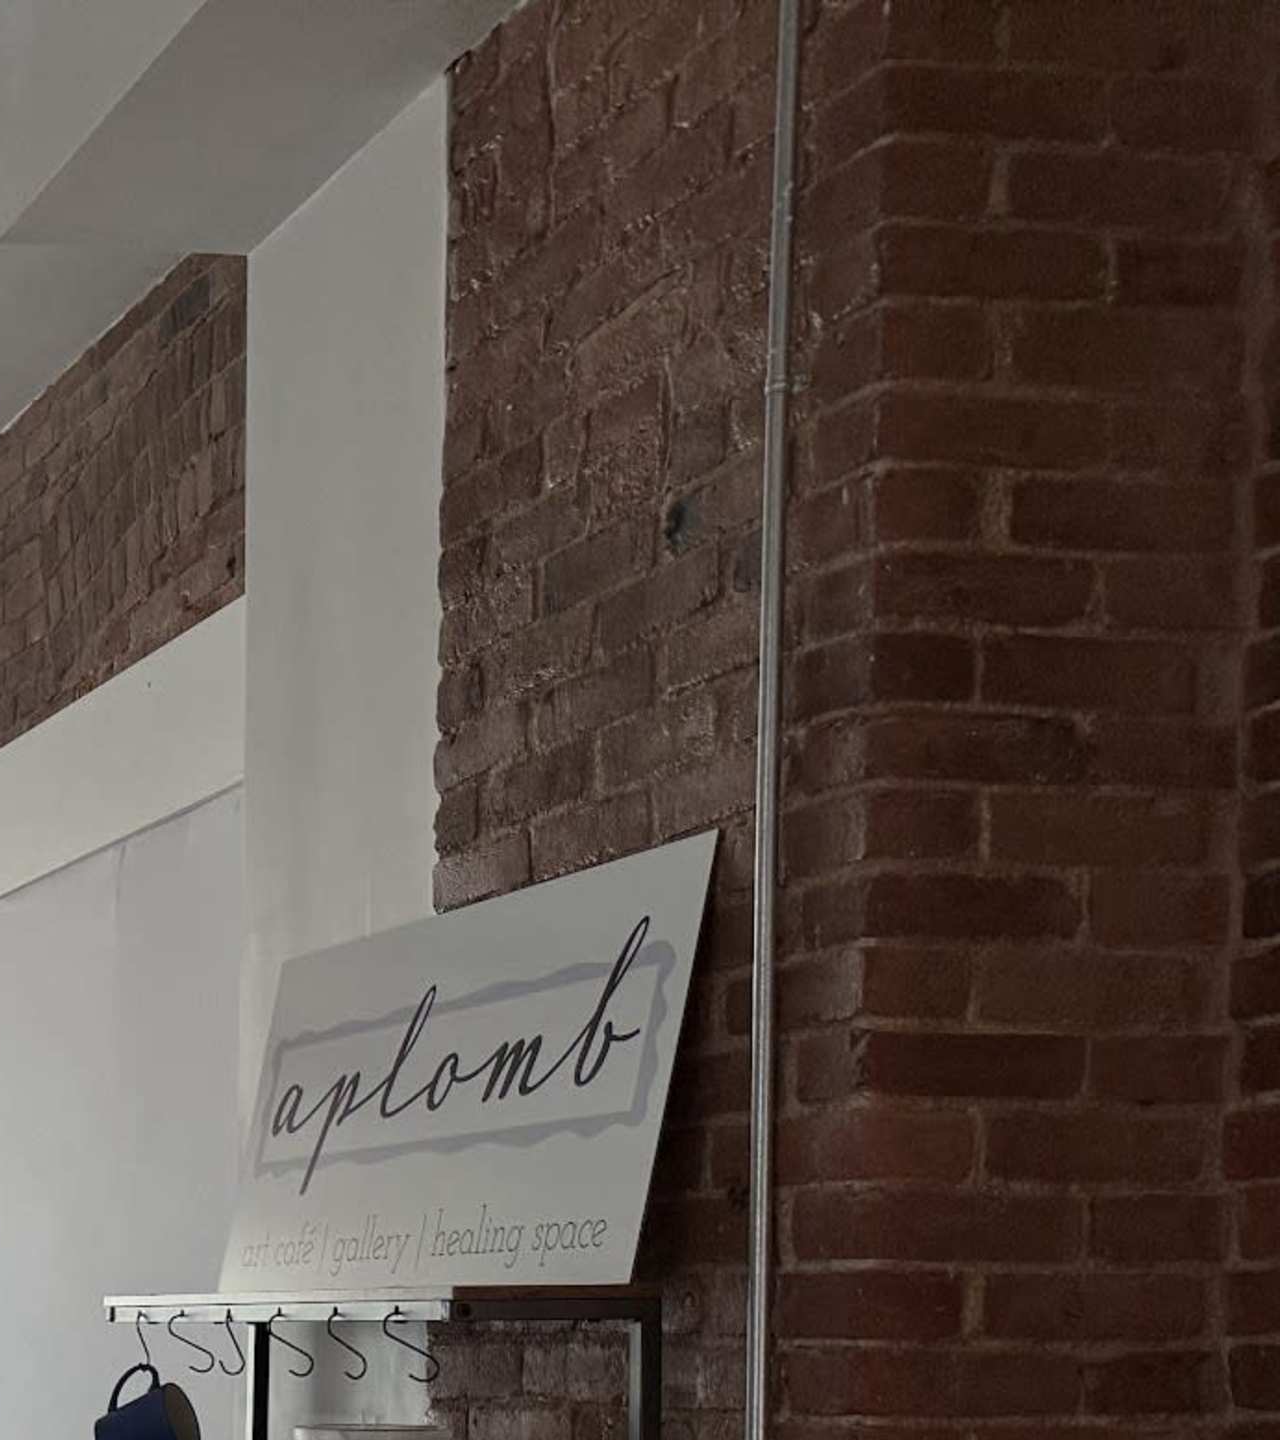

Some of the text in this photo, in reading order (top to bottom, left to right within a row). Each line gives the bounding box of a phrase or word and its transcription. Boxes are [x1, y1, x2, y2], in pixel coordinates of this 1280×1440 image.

[271, 914, 650, 1196] aplomb
[330, 1213, 412, 1276] gallery
[431, 1203, 525, 1269] healing
[531, 1217, 608, 1267] space
